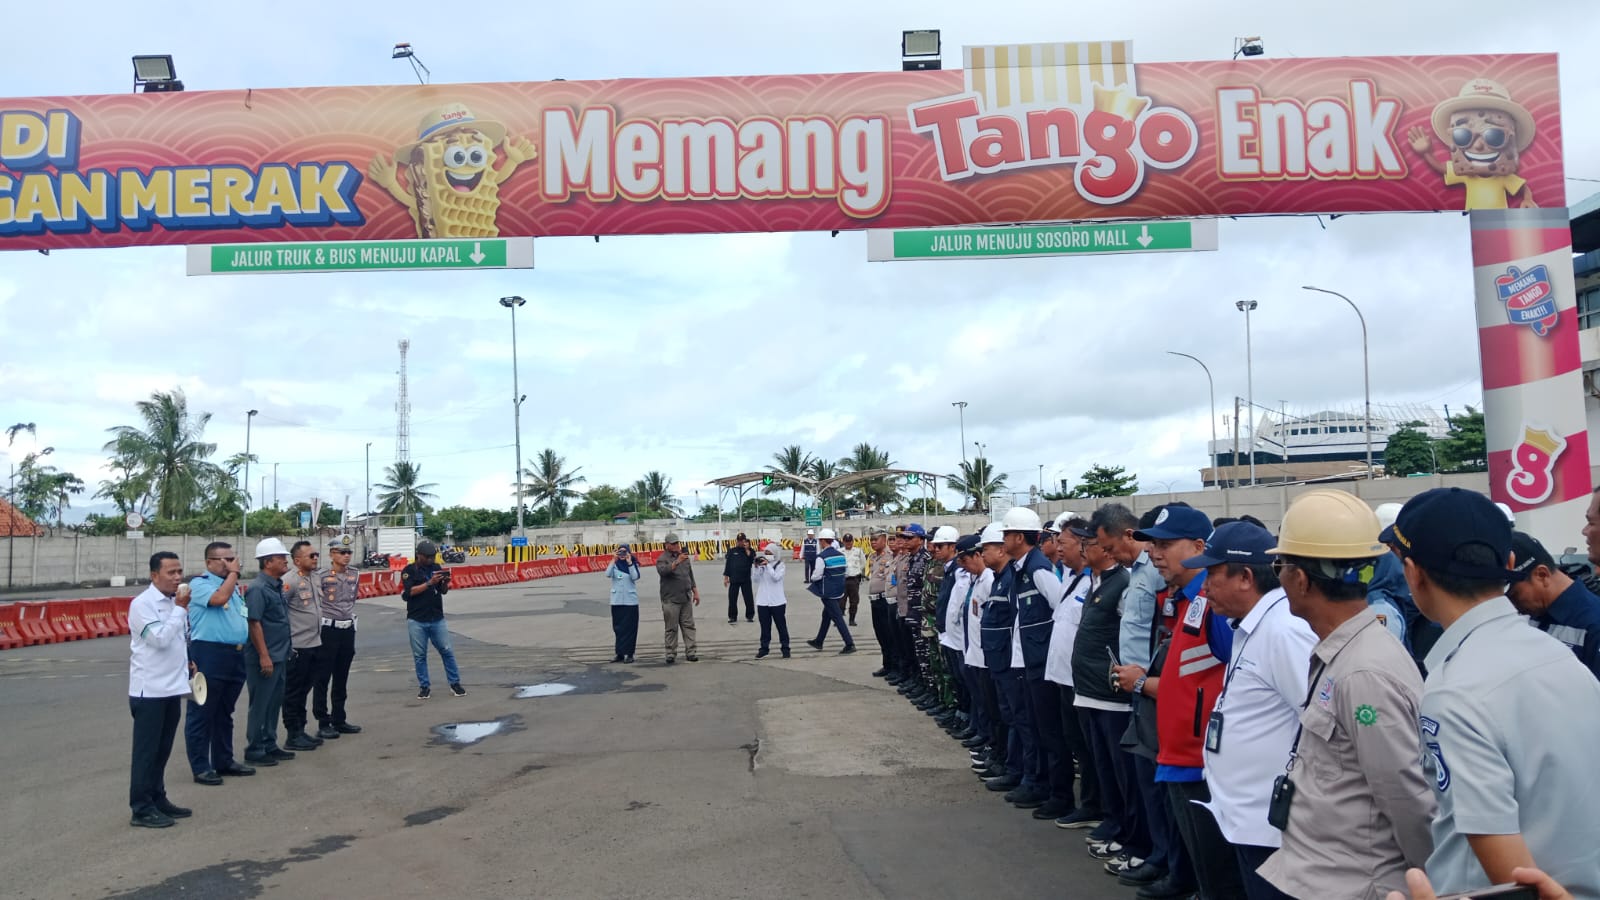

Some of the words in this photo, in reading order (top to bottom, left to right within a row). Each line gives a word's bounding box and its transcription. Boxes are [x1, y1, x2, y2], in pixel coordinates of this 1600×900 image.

[440, 109, 467, 121] Tango
[0, 110, 75, 163] DI
[541, 106, 887, 213] Memang
[911, 95, 1194, 199] Tango
[1216, 81, 1402, 175] Enak
[119, 163, 354, 223] MERAK
[931, 234, 972, 252] JALUR
[976, 232, 1032, 251] MENUJU
[1036, 230, 1090, 249] SOSORO
[1094, 229, 1129, 247] MALL
[231, 250, 272, 267] JALUR
[276, 248, 311, 266] TRUK
[314, 248, 326, 265] &
[329, 247, 356, 265] BUS
[360, 246, 416, 264] MENUJU
[420, 245, 462, 263] KAPAL
[1507, 273, 1537, 294] MEMANG
[1518, 285, 1543, 306] TANGO
[1520, 305, 1548, 320] ENAK!!!
